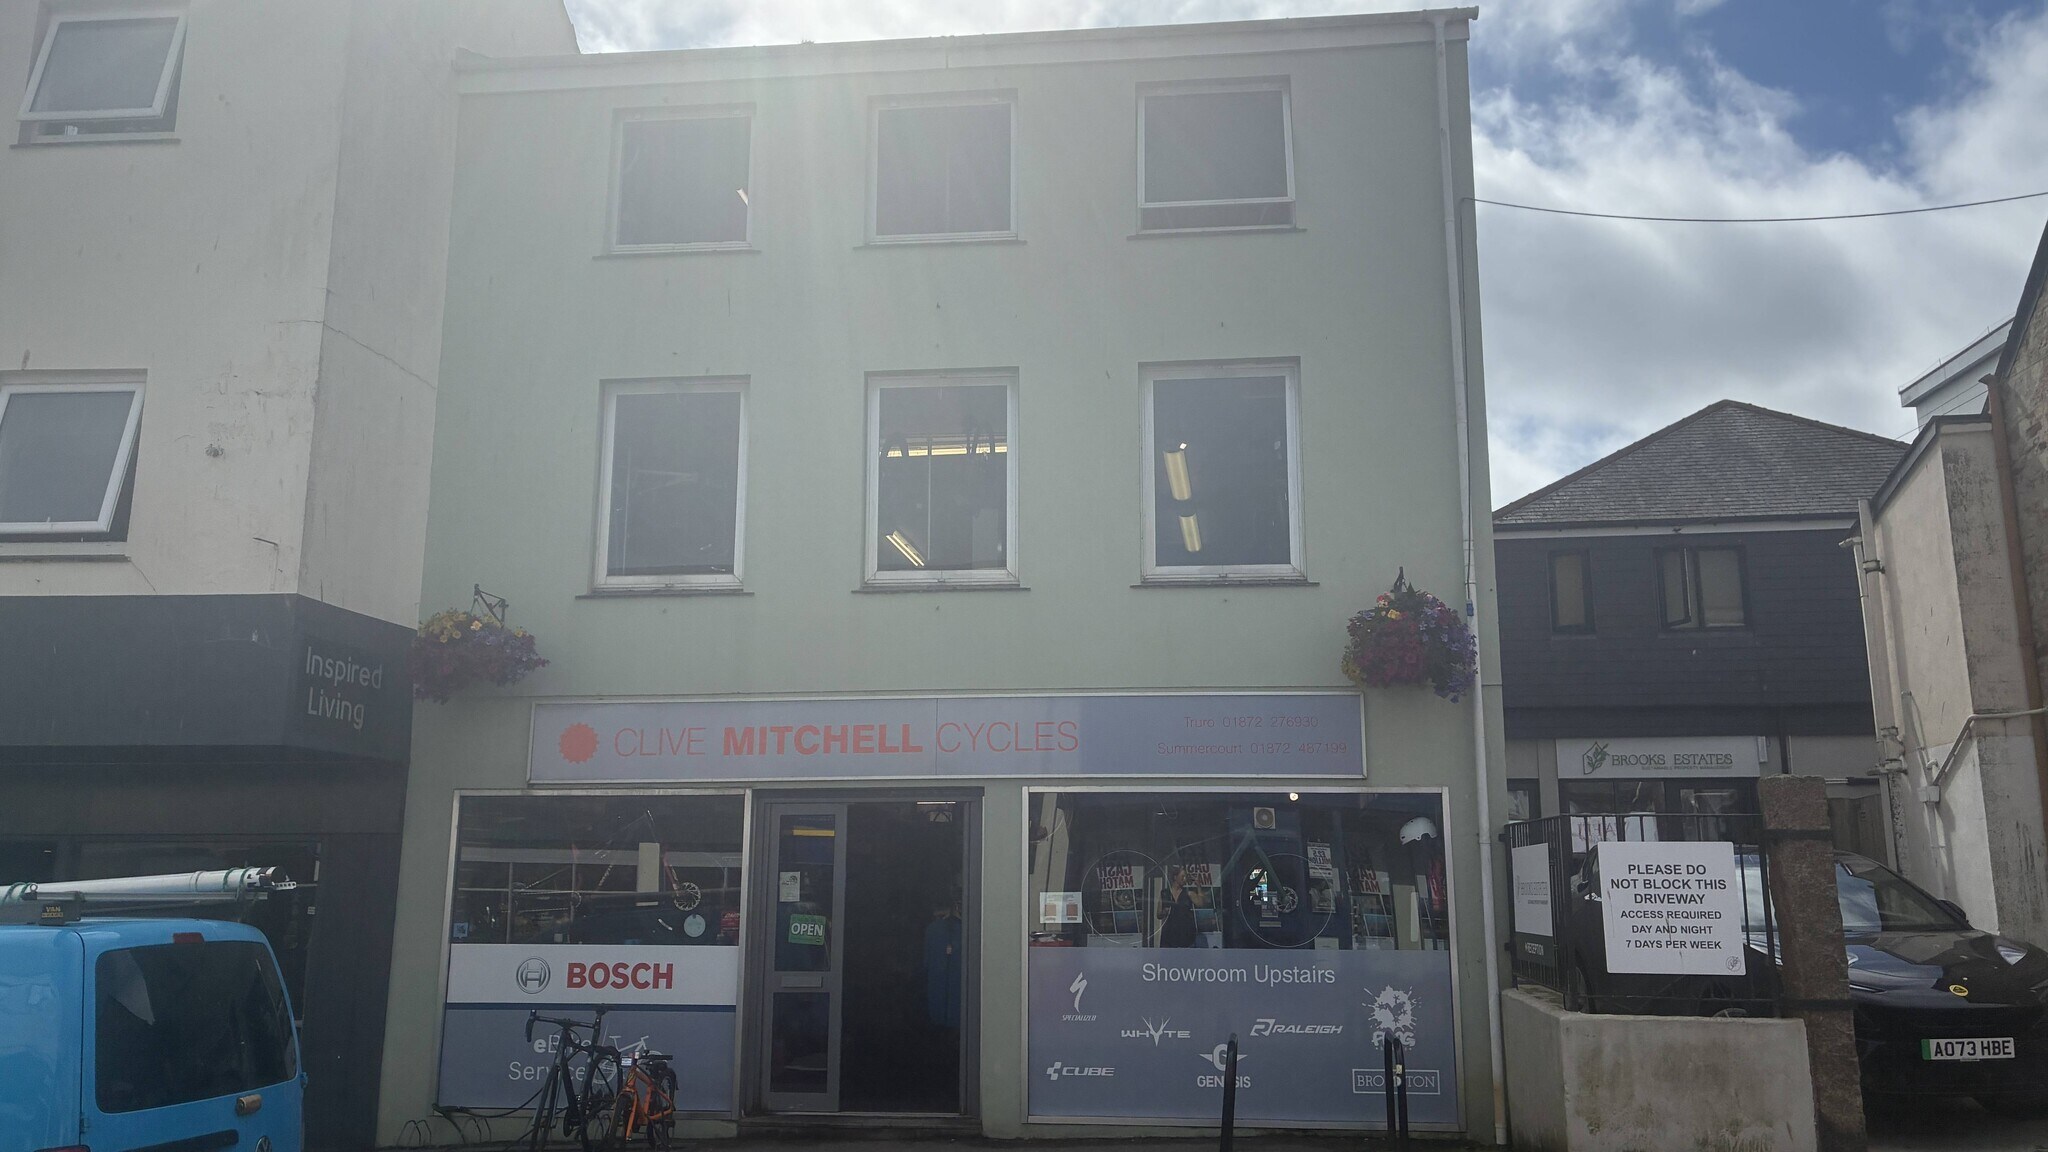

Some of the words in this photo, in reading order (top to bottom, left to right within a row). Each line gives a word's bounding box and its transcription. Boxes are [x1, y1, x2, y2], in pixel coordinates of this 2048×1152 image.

[306, 646, 382, 689] Inspired
[308, 686, 364, 729] Living
[1184, 716, 1215, 728] Truro
[1223, 716, 1262, 728] 01872
[614, 727, 707, 757] CLIVE
[722, 723, 923, 756] MITCHELL
[937, 721, 1079, 753] CYCLES
[1158, 742, 1243, 755] Summercourt
[1250, 742, 1290, 754] 01872
[1611, 753, 1666, 766] BROOKS
[1673, 753, 1733, 765] ESTATES
[1628, 864, 1682, 875] PLEASE
[1686, 864, 1707, 875] DO
[1611, 878, 1639, 889] NOT
[1643, 879, 1692, 890] BLOCK
[1695, 879, 1727, 890] THIS
[1634, 893, 1706, 904] DRIVEWAY
[1620, 910, 1664, 919] ACCESS
[1666, 910, 1722, 920] REQUIRED
[791, 922, 824, 936] OPEN
[1632, 925, 1653, 934] DAY
[1655, 925, 1678, 934] AND
[1680, 926, 1713, 935] NIGHT
[1626, 940, 1632, 948] 7
[1635, 940, 1663, 949] DAYS
[1666, 940, 1688, 949] PER
[1690, 941, 1722, 950] WEEK
[566, 962, 674, 990] BOSCH
[1142, 962, 1247, 983] Showroom
[1254, 964, 1336, 987] Upstairs
[1121, 1016, 1191, 1046] WHYTE
[1272, 1025, 1344, 1035] RALEIGH
[533, 1034, 592, 1054] eBe
[1372, 1031, 1416, 1047] FOG
[1934, 1041, 1977, 1057] AO73
[1980, 1040, 2012, 1056] HBE
[508, 1061, 586, 1081] Sere
[1062, 1067, 1116, 1077] CUBE
[1196, 1075, 1252, 1089] GENSIS
[1357, 1075, 1435, 1088] BROTON
